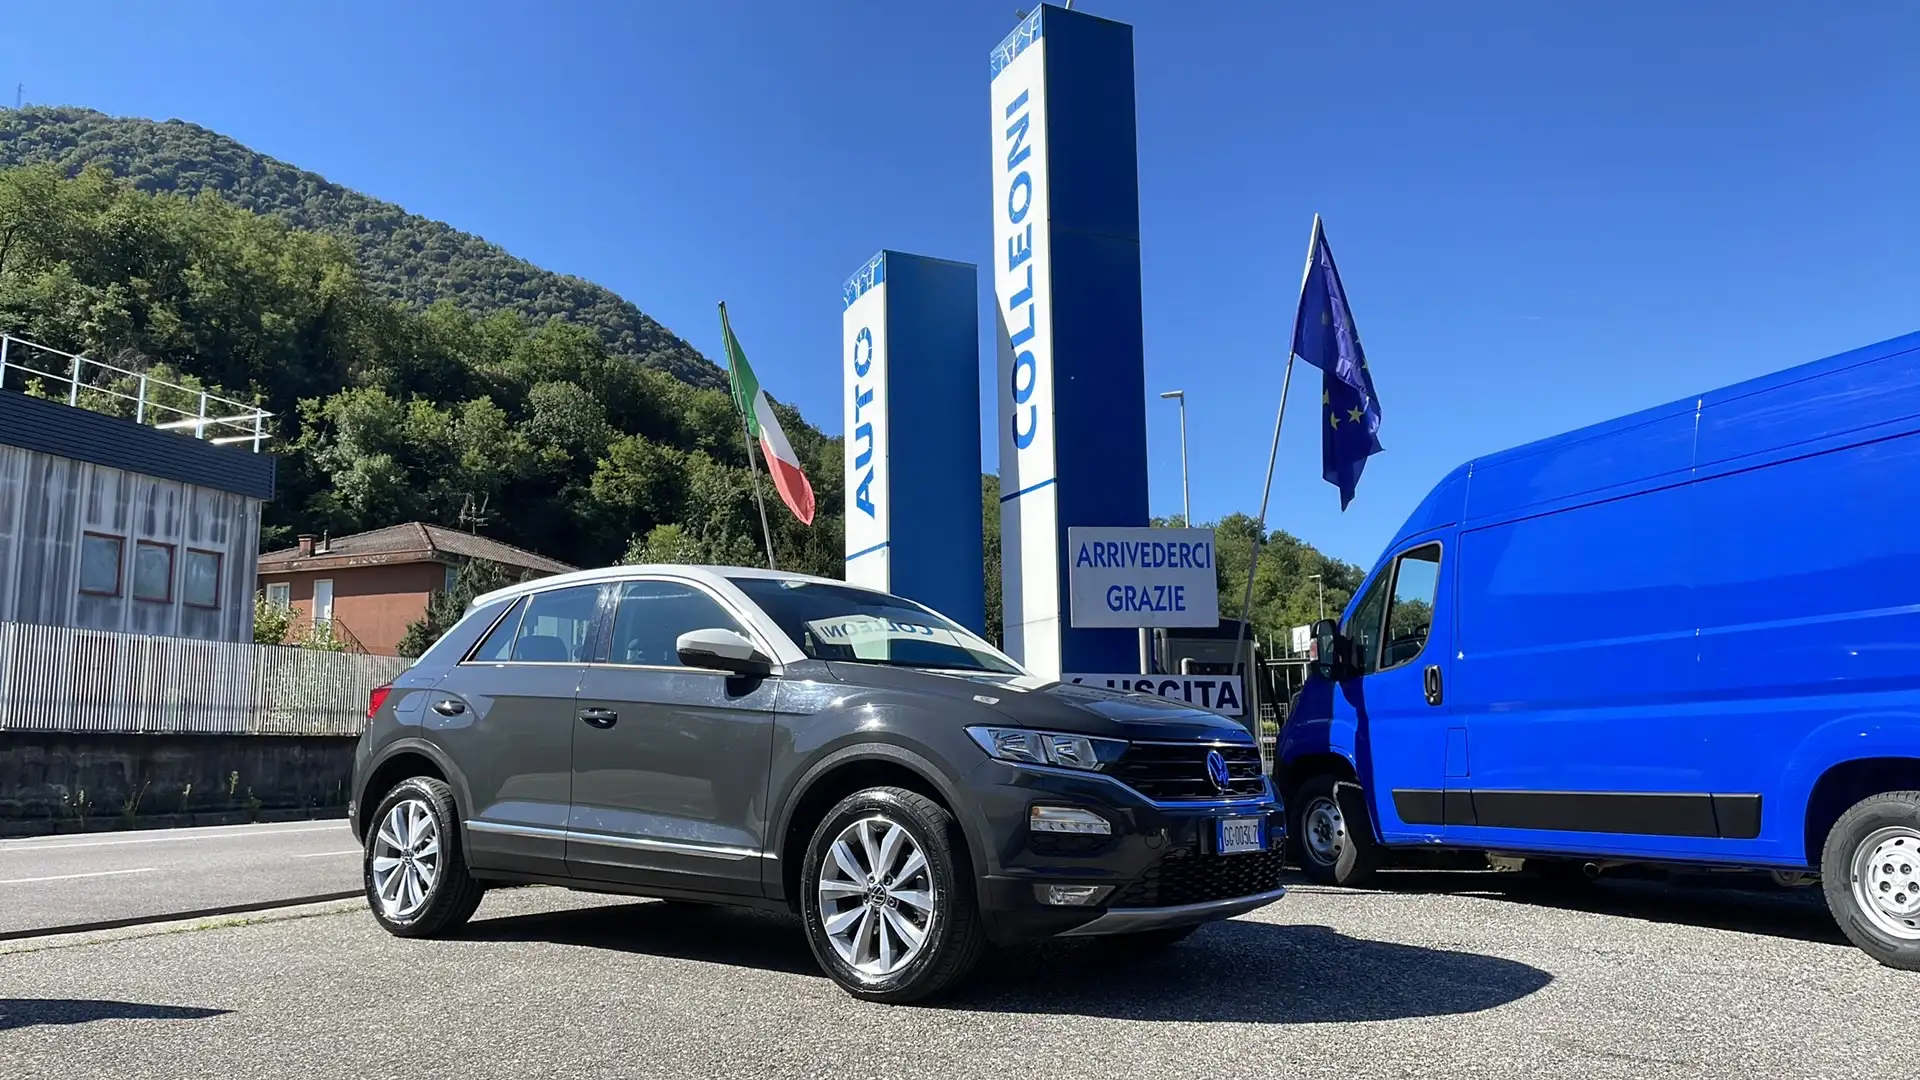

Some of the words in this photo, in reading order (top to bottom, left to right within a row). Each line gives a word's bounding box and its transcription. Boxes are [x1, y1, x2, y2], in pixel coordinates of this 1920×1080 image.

[1005, 88, 1037, 450] COLLEONI
[854, 326, 875, 519] AUTO
[1076, 541, 1211, 569] ARRIVEDERCI
[1106, 585, 1186, 612] GRAZIE
[1106, 679, 1240, 710] CITA
